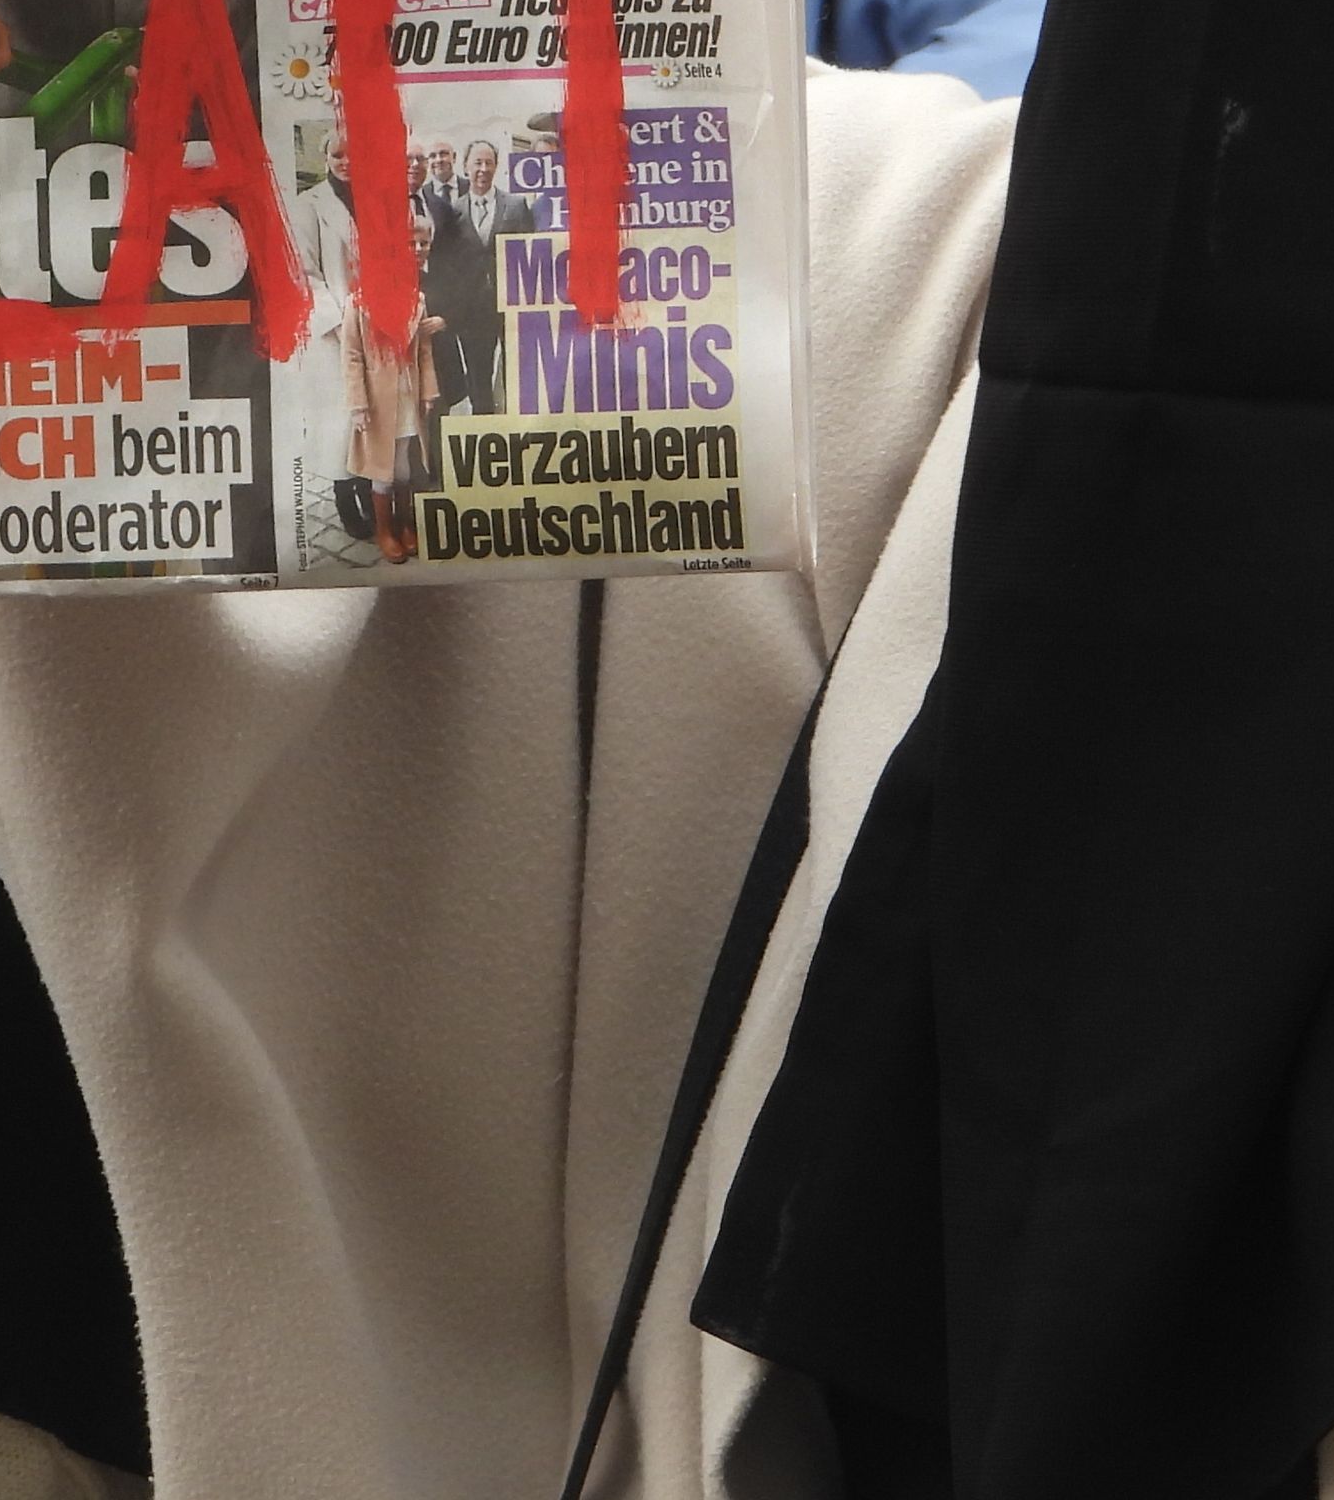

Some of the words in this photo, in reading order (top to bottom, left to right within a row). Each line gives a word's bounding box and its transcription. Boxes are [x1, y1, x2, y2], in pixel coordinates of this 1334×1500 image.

[445, 18, 528, 64] Euro
[685, 63, 713, 79] Seite
[714, 64, 723, 78] 4
[693, 110, 728, 144] &
[692, 151, 729, 183] in
[517, 304, 734, 416] Minis
[113, 411, 242, 477] beim
[447, 416, 739, 489] verzaubern
[293, 456, 303, 508] WALLOCHA
[295, 508, 307, 549] STEPHAN
[422, 486, 745, 561] Deutschland
[683, 557, 719, 571] Letzte
[721, 557, 752, 571] Seite
